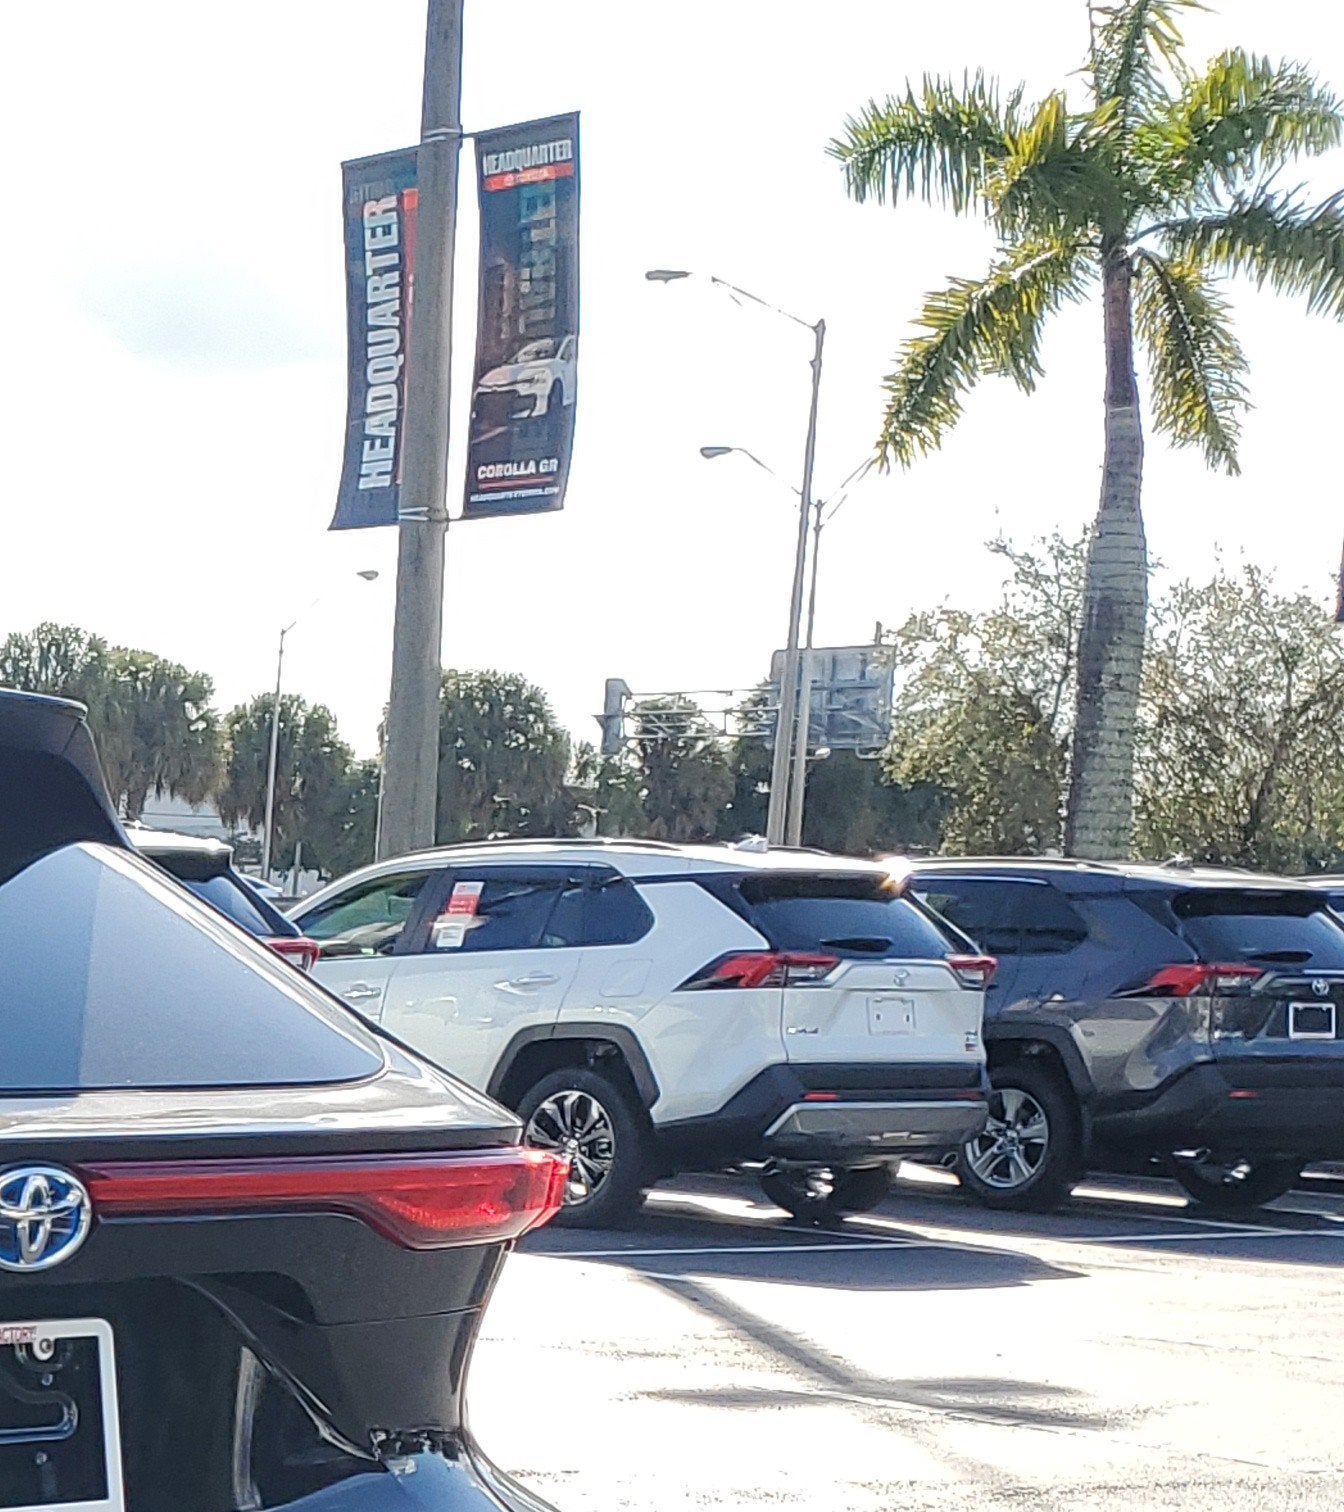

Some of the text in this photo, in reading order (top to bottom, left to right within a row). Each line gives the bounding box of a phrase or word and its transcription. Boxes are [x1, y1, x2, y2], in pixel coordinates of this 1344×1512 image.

[358, 194, 405, 490] HEADQUARTER
[477, 457, 559, 480] COROLLA GR
